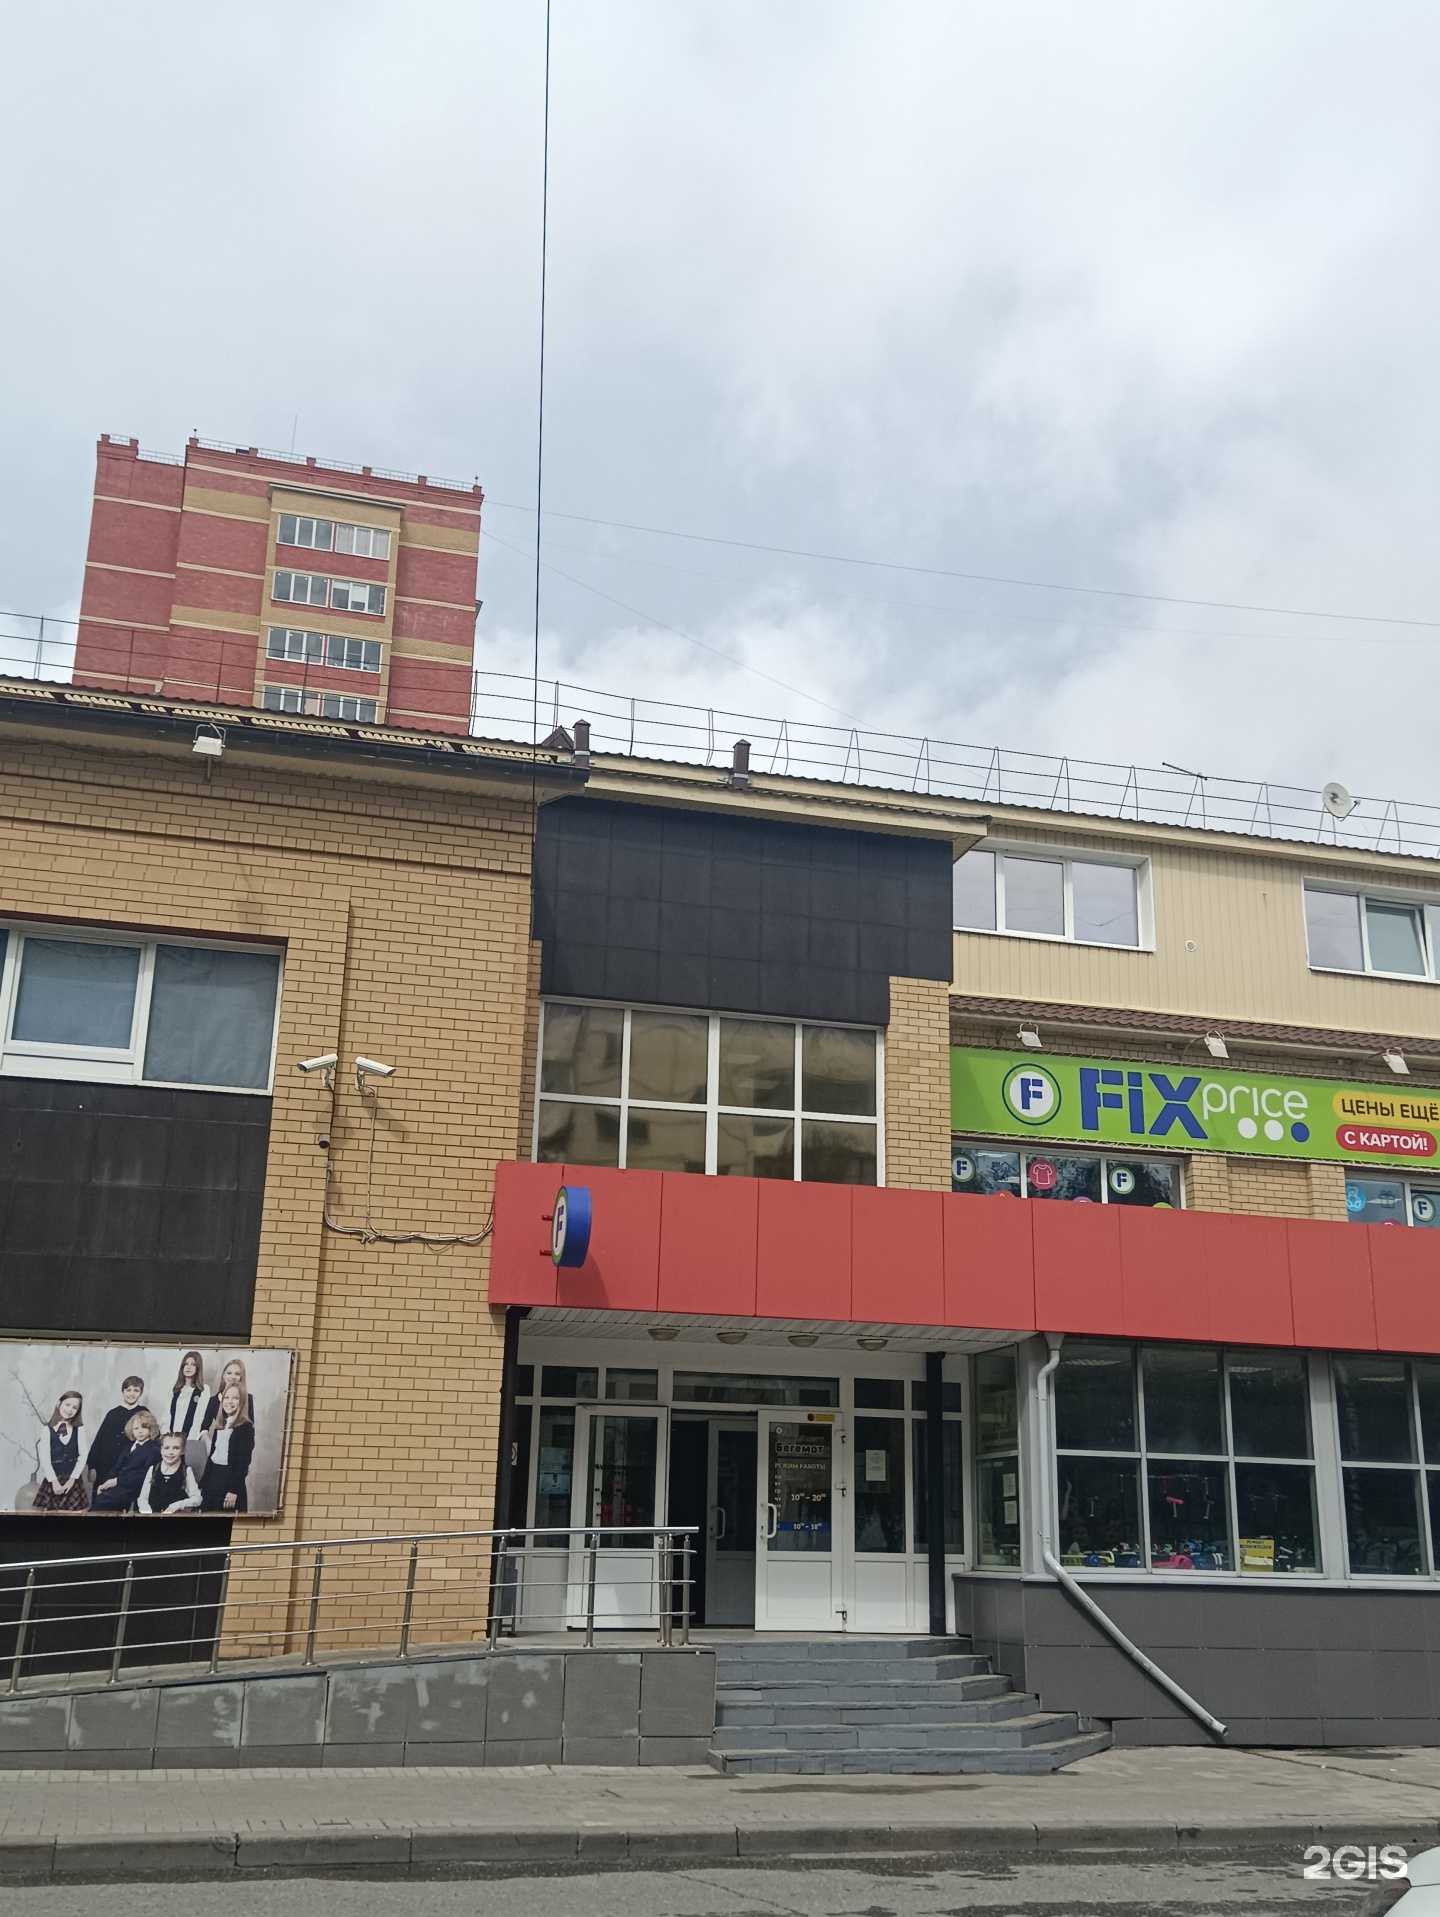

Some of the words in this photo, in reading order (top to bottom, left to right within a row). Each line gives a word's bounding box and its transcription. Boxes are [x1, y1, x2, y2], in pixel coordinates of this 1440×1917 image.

[1020, 1077, 1043, 1110] F
[1202, 1082, 1309, 1120] price
[1341, 1098, 1394, 1118] ЦЕНЫ
[1400, 1102, 1440, 1123] ЕЩЁ
[1344, 1130, 1356, 1145] С
[1359, 1131, 1429, 1151] КАРТОЙ!
